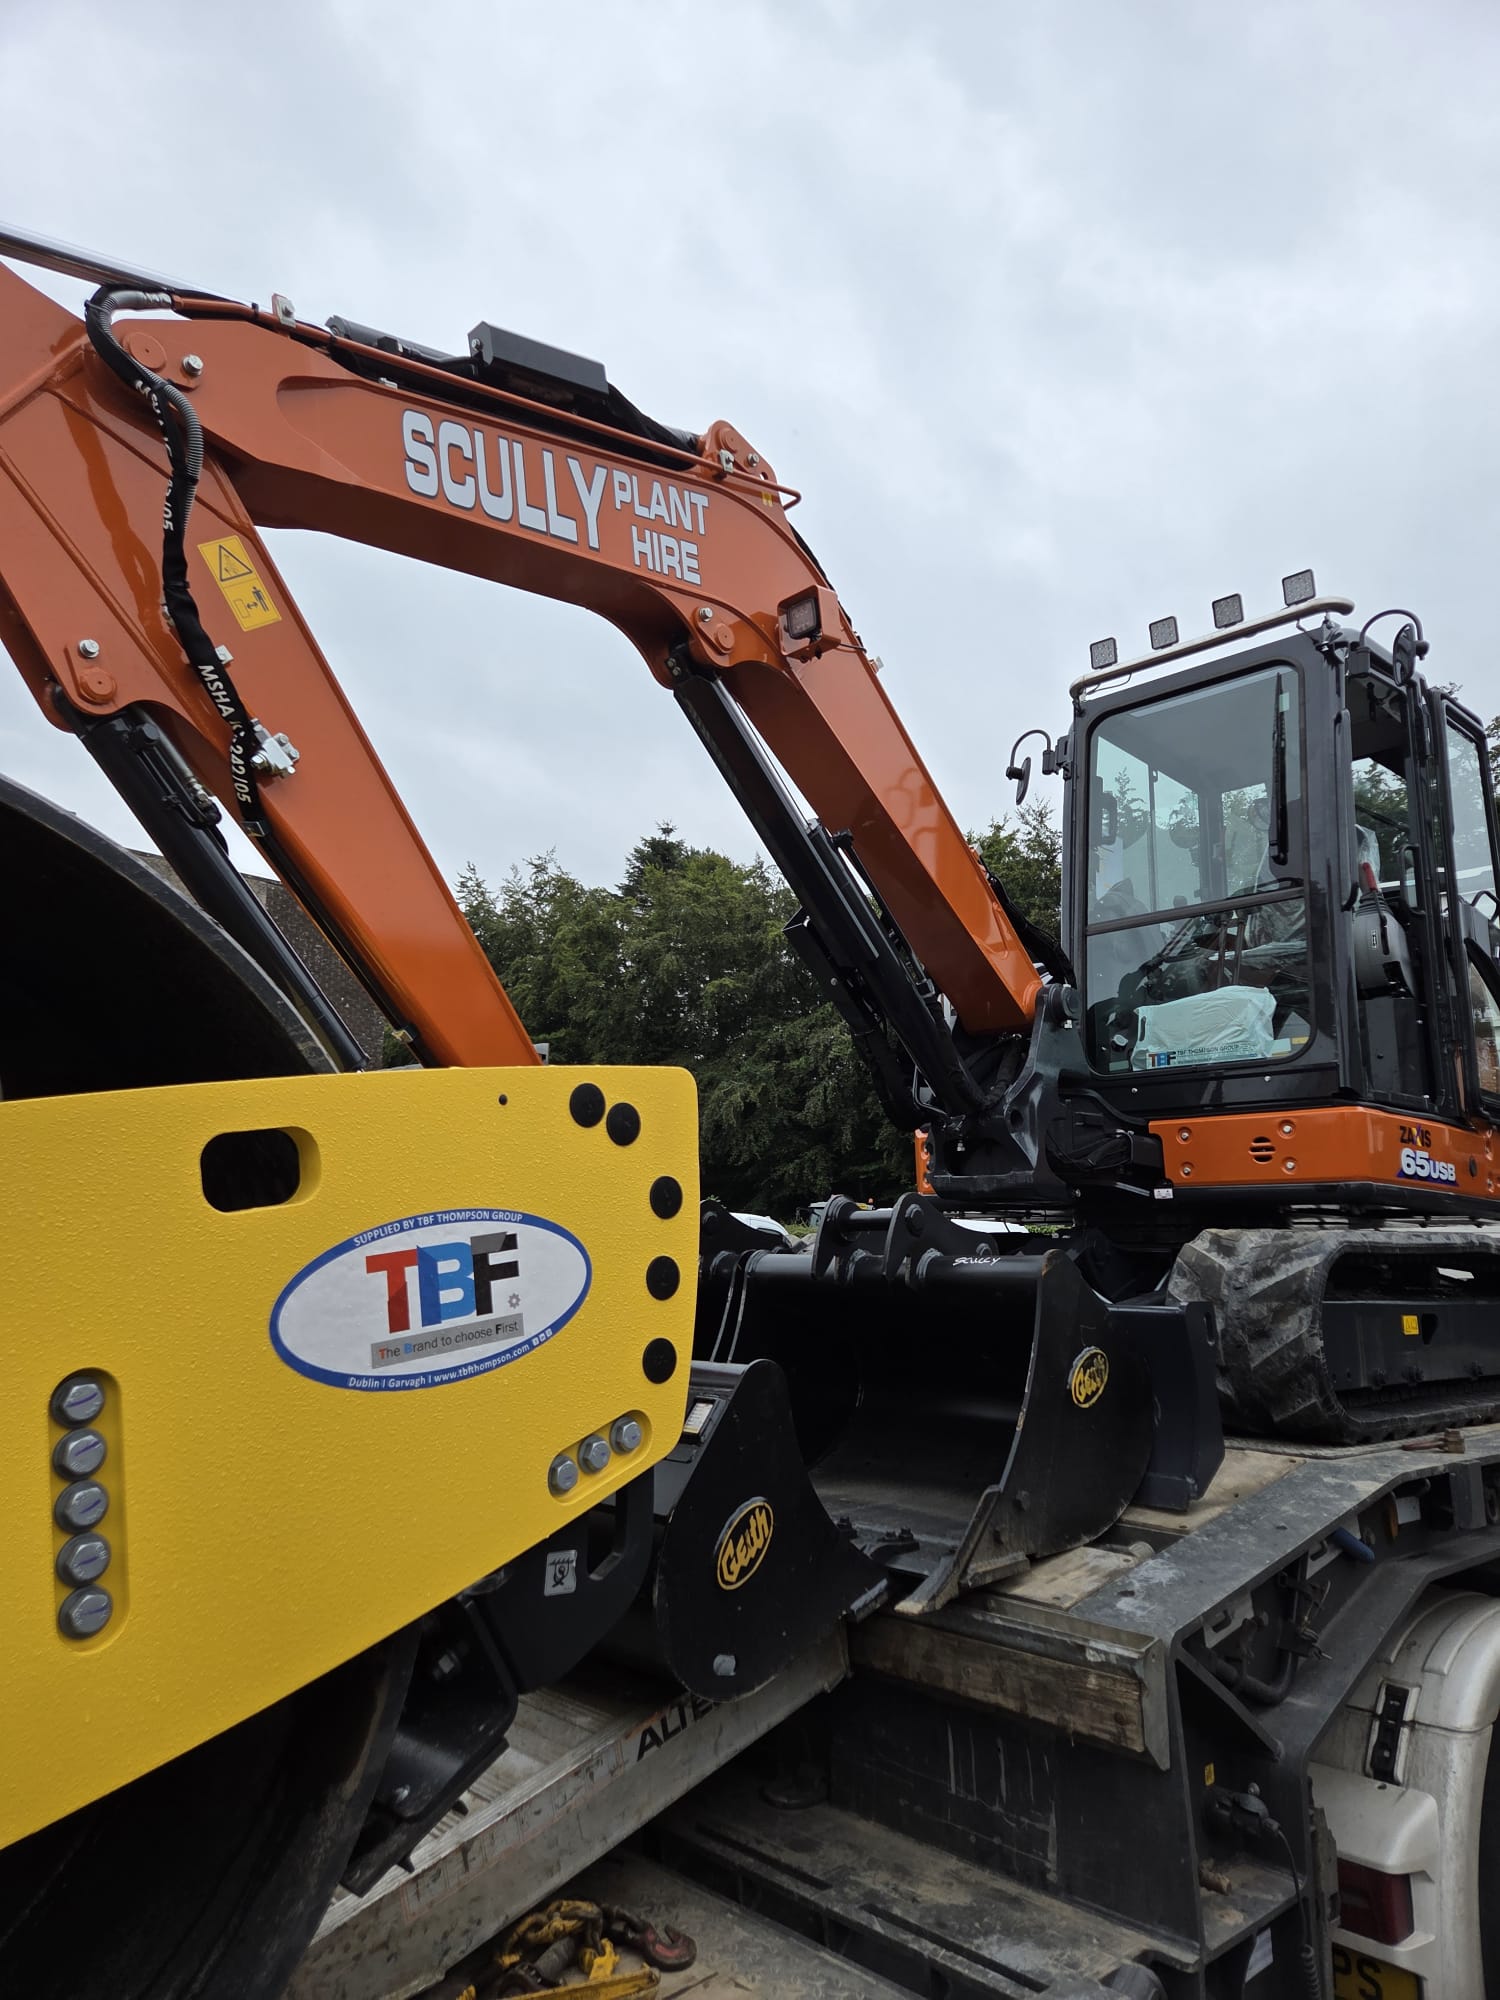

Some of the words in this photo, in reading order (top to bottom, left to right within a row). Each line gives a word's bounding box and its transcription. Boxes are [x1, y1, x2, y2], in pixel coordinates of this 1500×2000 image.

[402, 409, 608, 550] SCULLY
[612, 468, 709, 536] PLANT
[630, 524, 701, 586] HIRE
[198, 665, 235, 718] MSHA
[1148, 1051, 1177, 1068] TBF
[1400, 1147, 1457, 1182] 65USB
[353, 1222, 401, 1247] SUPPLIED
[402, 1218, 415, 1230] BY
[416, 1214, 435, 1227] TBF
[437, 1211, 490, 1223] THOMPSON
[491, 1211, 523, 1223] GROUP
[365, 1231, 520, 1334] TBF
[378, 1346, 401, 1360] The
[403, 1336, 438, 1355] Brand
[441, 1335, 452, 1347] to
[454, 1326, 493, 1345] choose
[495, 1320, 519, 1335] First
[348, 1376, 380, 1389] Dublin
[388, 1375, 426, 1389] Garvagh
[434, 1343, 530, 1383] www.tbfthompson.com
[636, 1696, 747, 1763] ALTE
